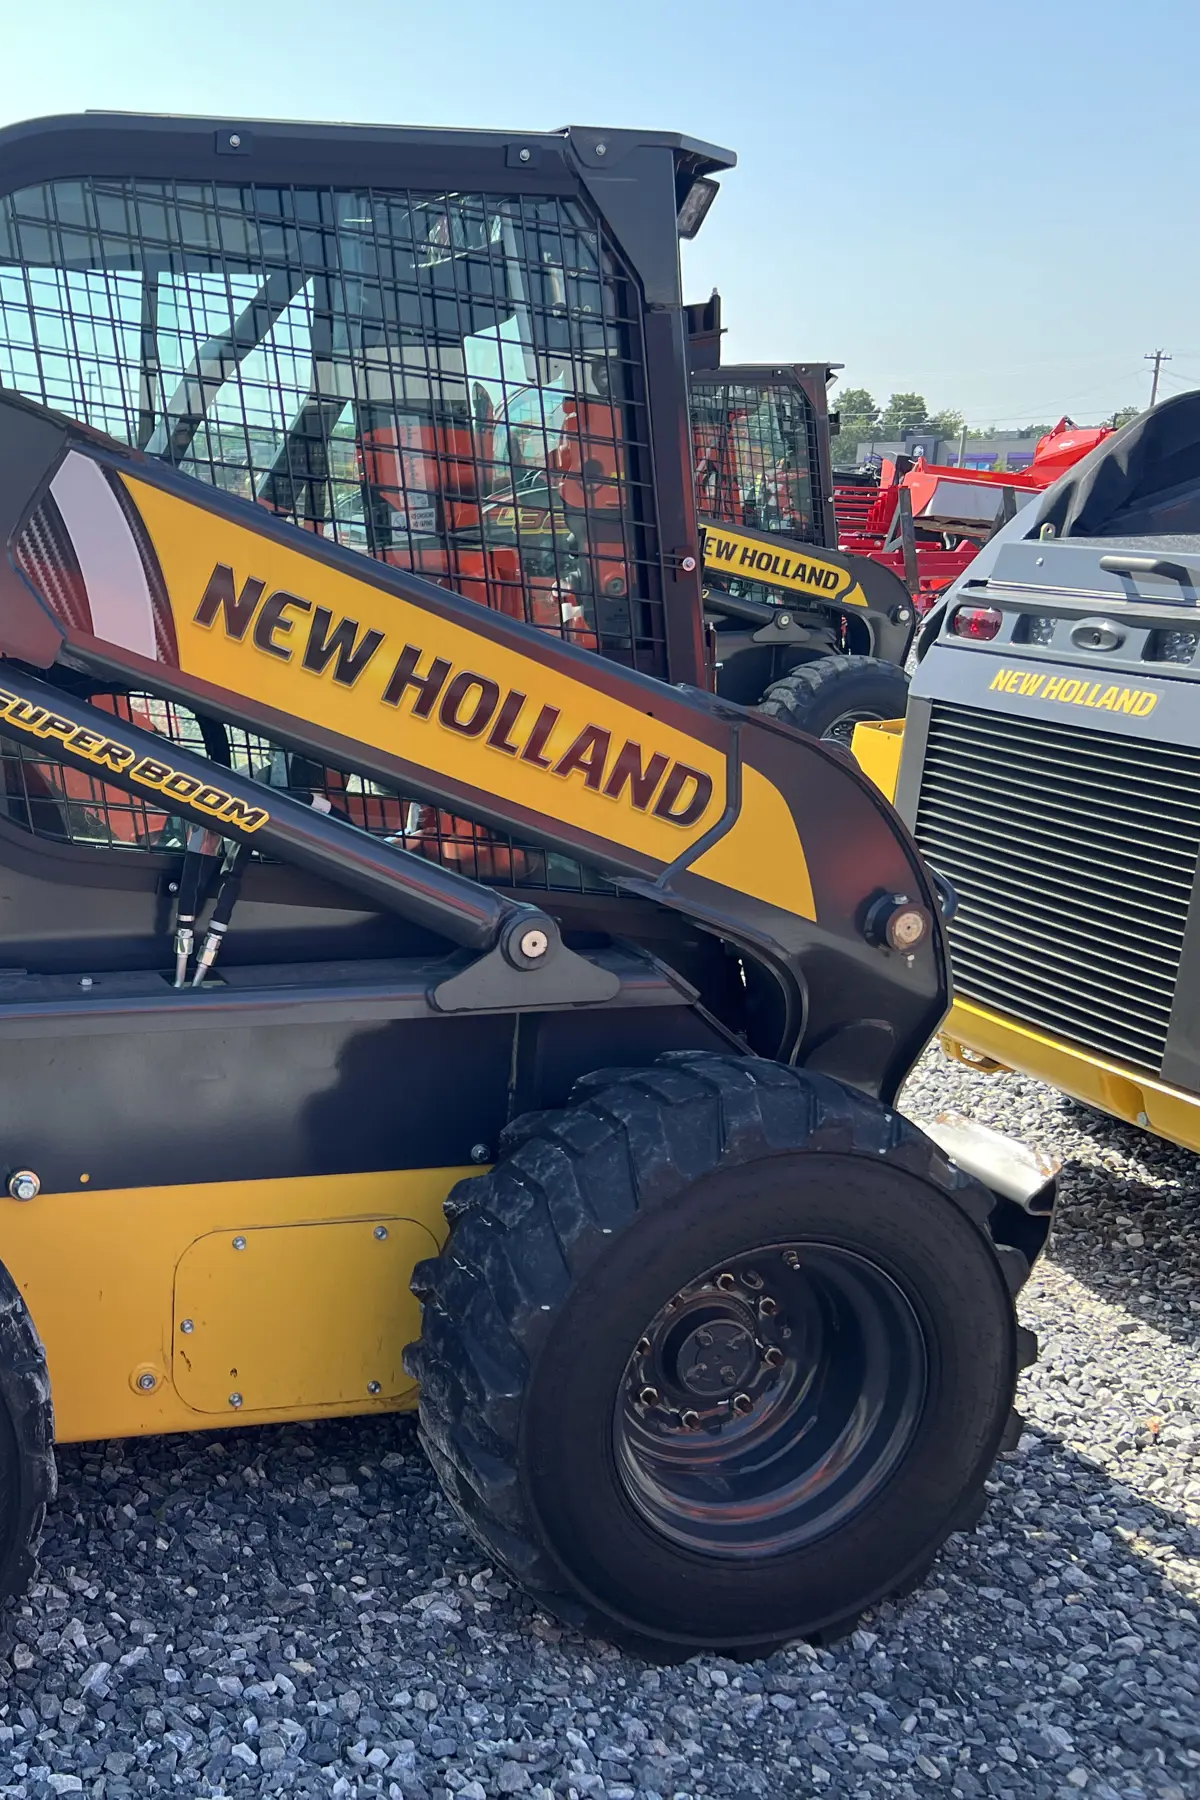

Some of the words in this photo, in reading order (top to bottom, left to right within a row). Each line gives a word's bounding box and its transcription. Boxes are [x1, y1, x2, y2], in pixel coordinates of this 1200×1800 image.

[704, 536, 738, 561] EW
[739, 547, 840, 590] HOLLAND
[193, 561, 386, 688] NEW
[381, 643, 714, 829] HOLLAND
[989, 669, 1046, 697] NEW
[1040, 676, 1158, 717] HOLLAND
[130, 757, 269, 832] BOOM
